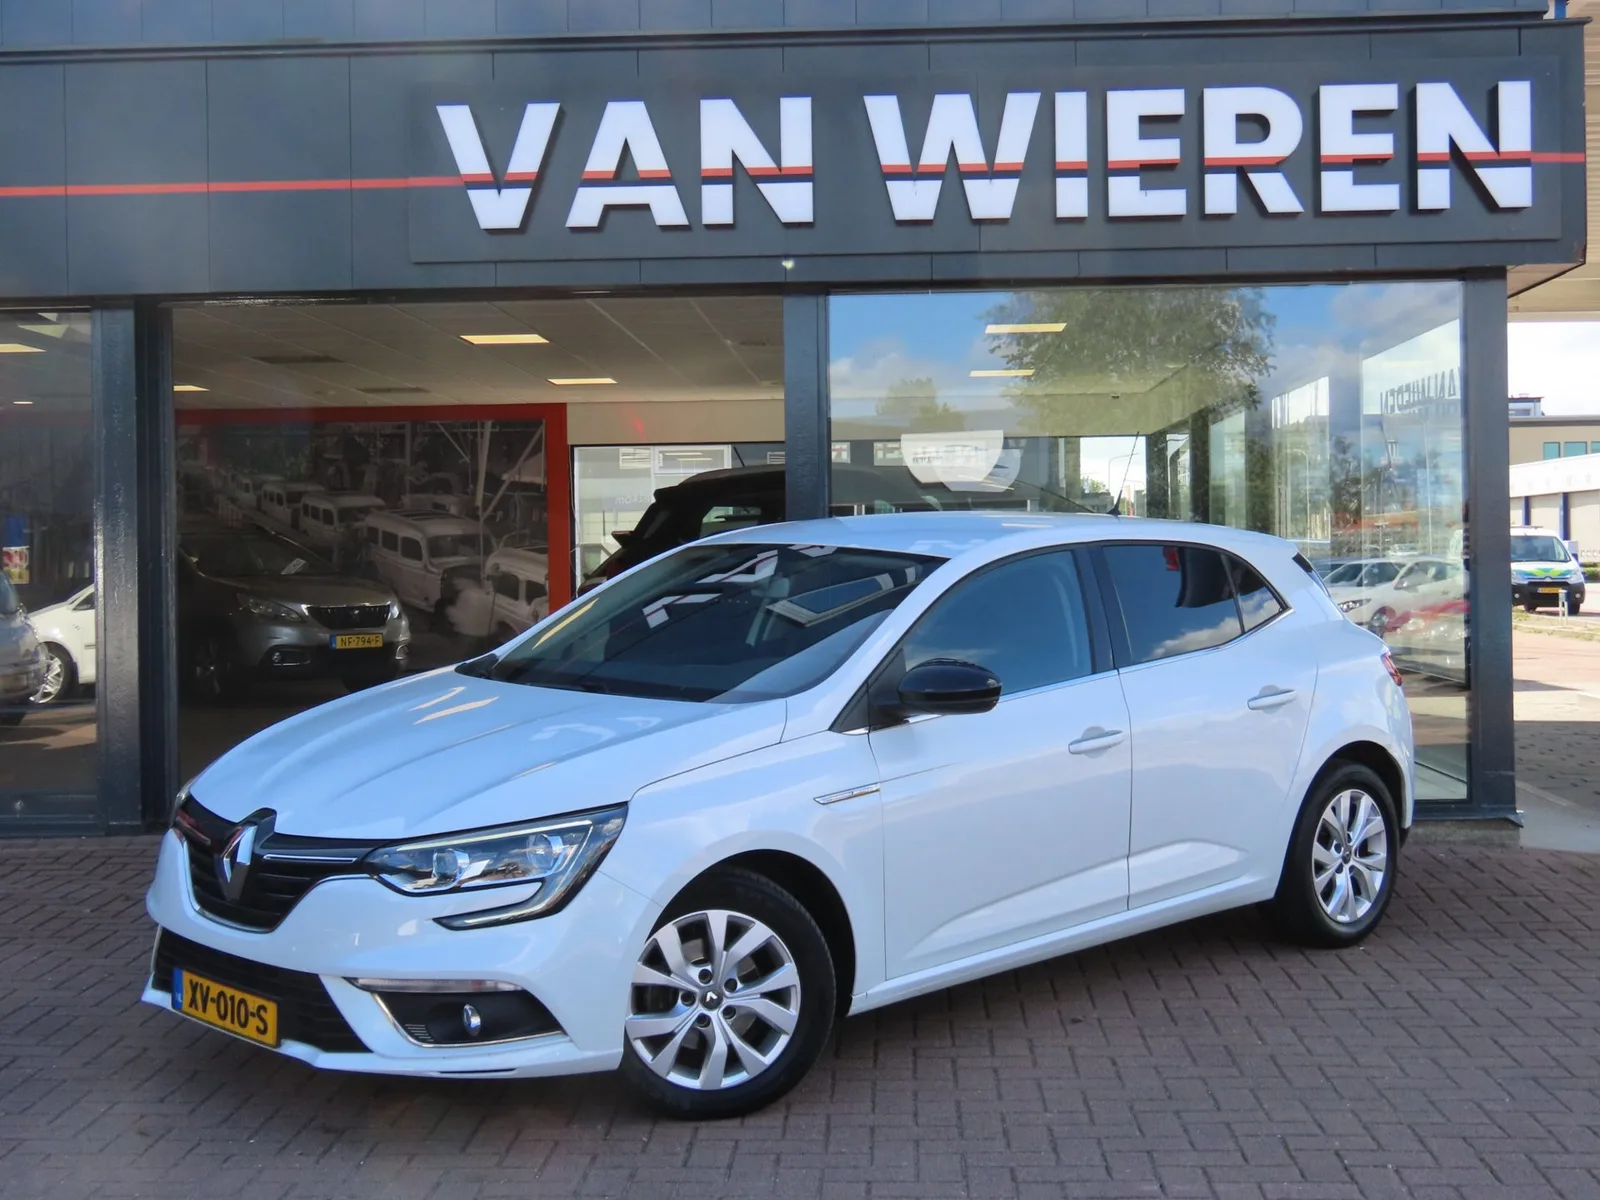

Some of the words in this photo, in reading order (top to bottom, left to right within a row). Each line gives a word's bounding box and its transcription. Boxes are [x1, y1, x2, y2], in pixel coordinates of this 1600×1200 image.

[436, 96, 815, 231] VAN
[864, 81, 1533, 221] WIEREN
[188, 979, 268, 1036] XV-010-S
